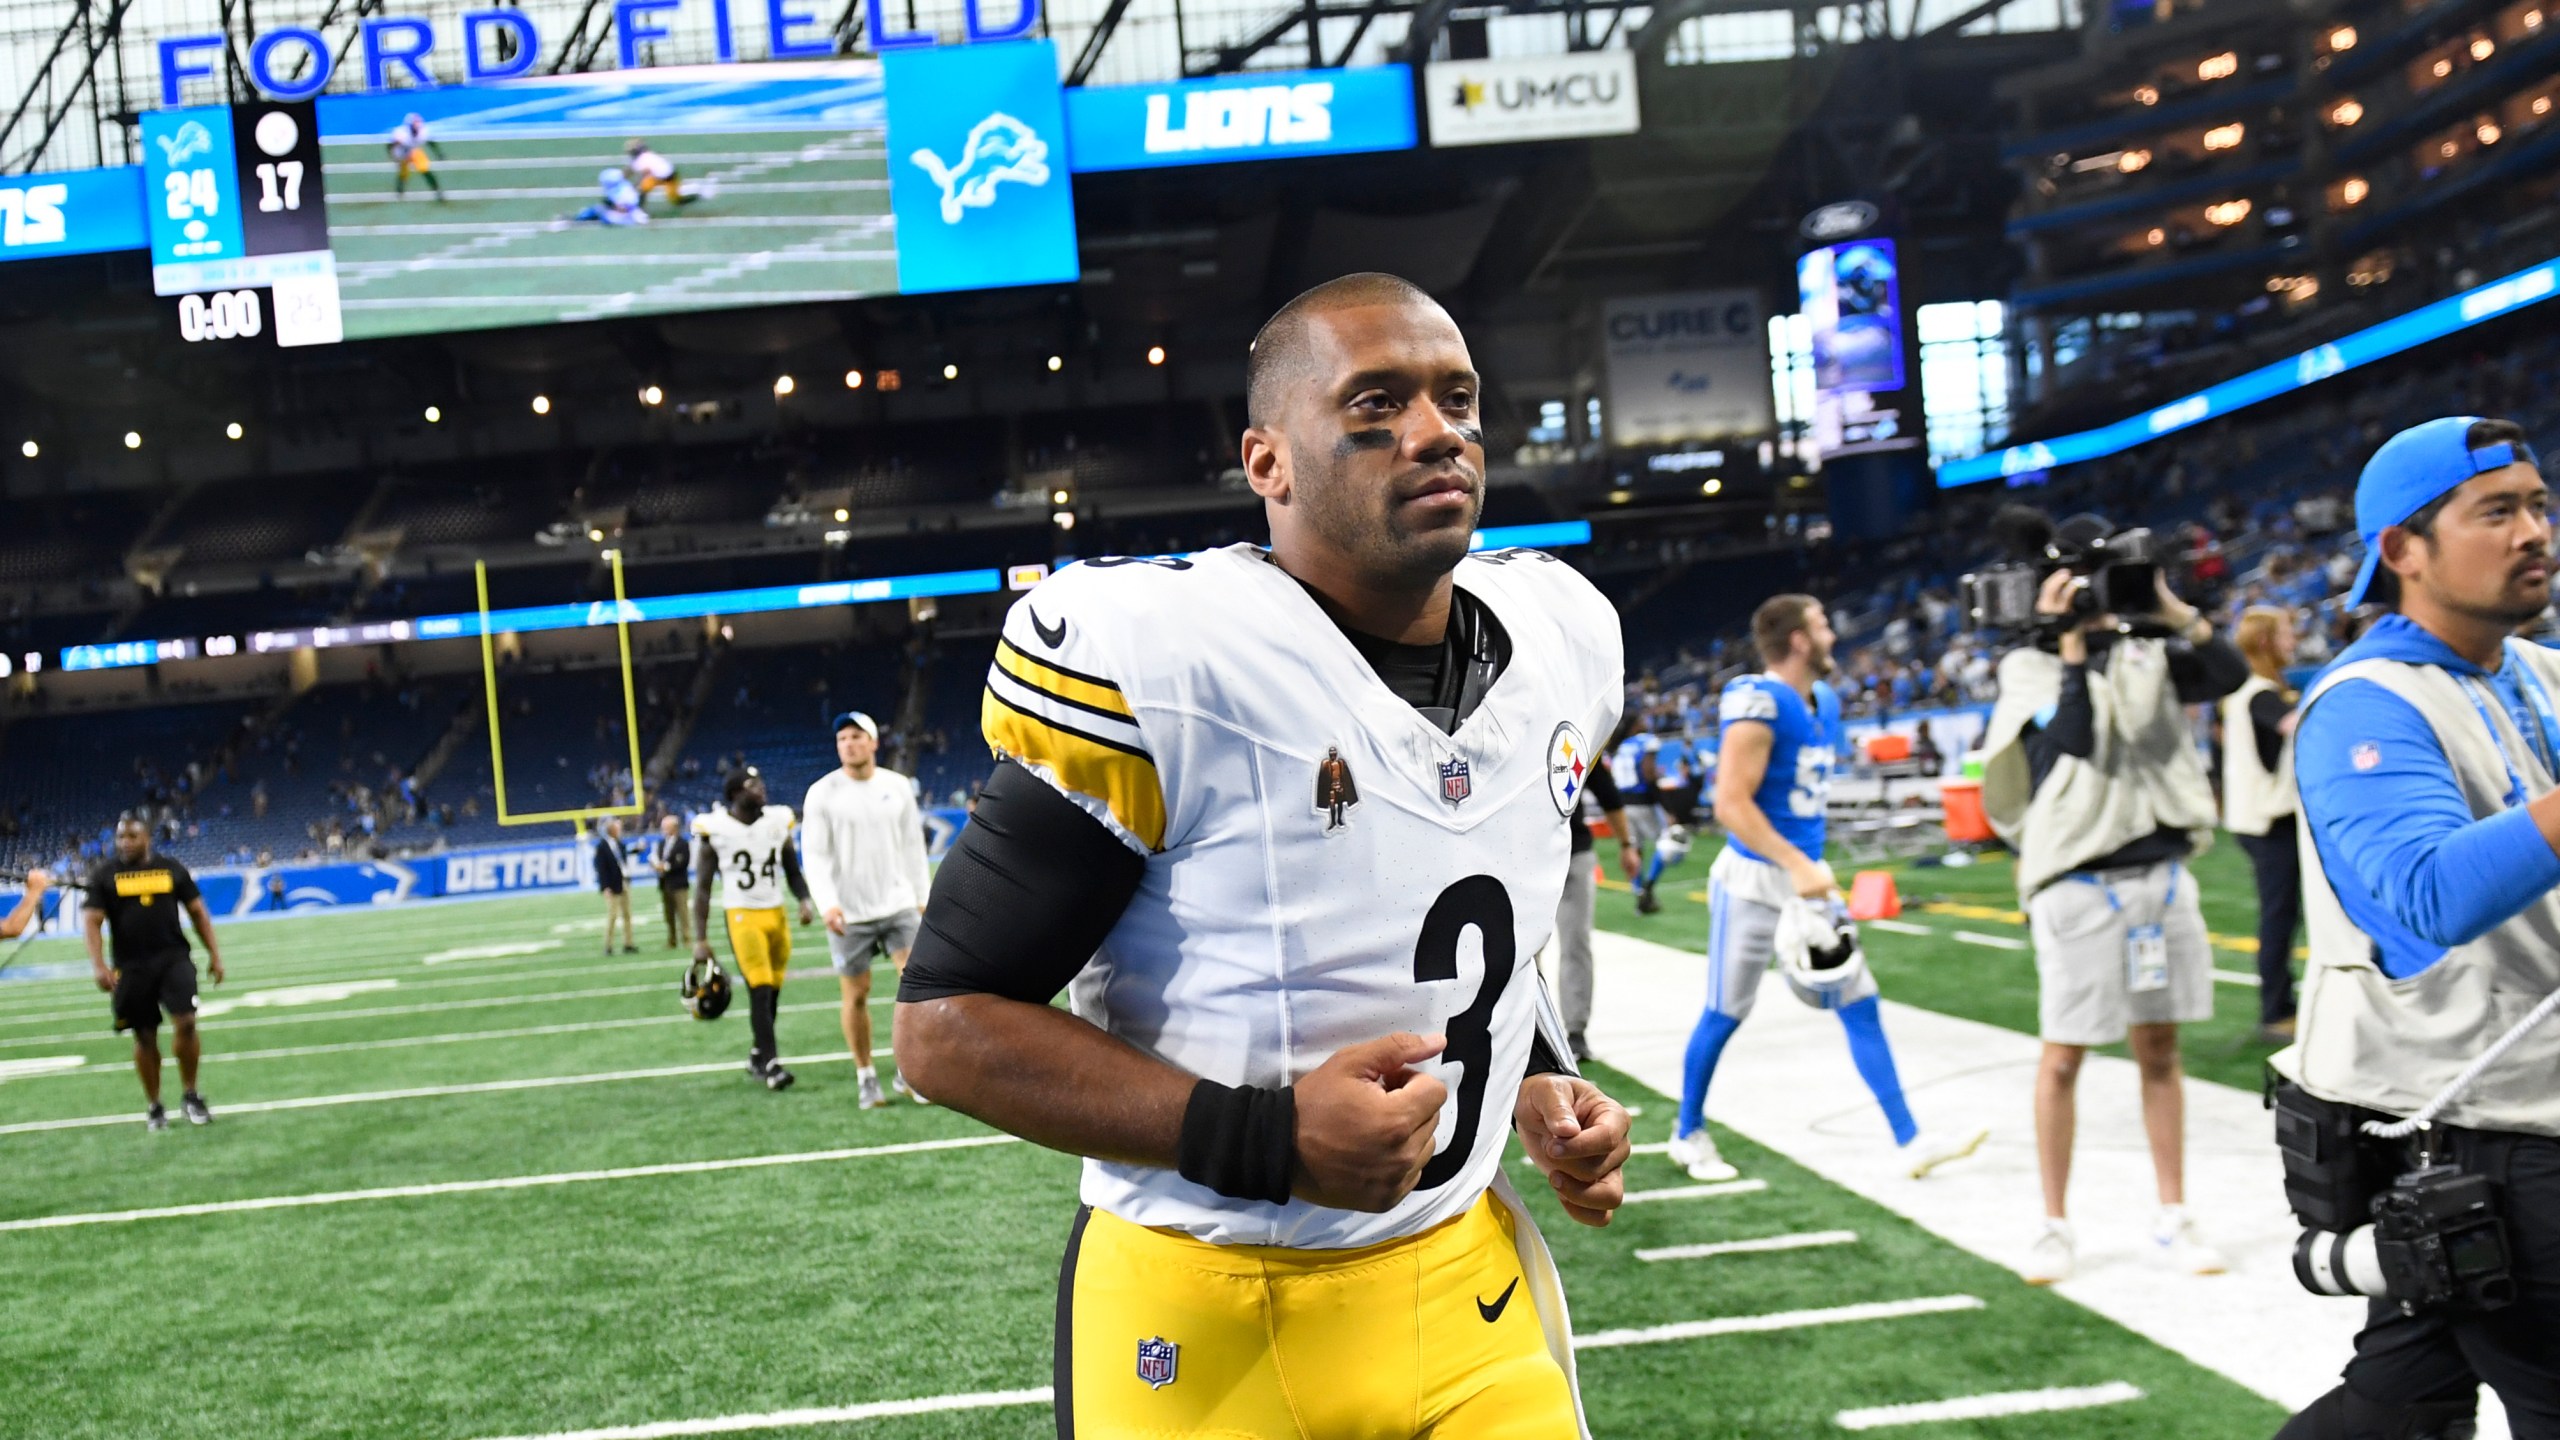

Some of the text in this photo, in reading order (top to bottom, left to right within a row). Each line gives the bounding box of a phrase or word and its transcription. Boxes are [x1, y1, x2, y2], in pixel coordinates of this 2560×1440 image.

[158, 0, 1041, 107] FORD FIELD
[1496, 71, 1619, 110] UMCU
[1145, 82, 1334, 154] LIONS
[165, 168, 219, 220] 24
[256, 161, 304, 212] 17
[178, 289, 262, 343] 0:00
[1610, 307, 1717, 341] CURE
[1446, 777, 1468, 799] NFL
[732, 847, 777, 890] 34
[1414, 873, 1516, 1191] 3
[1142, 1358, 1168, 1380] NFL
